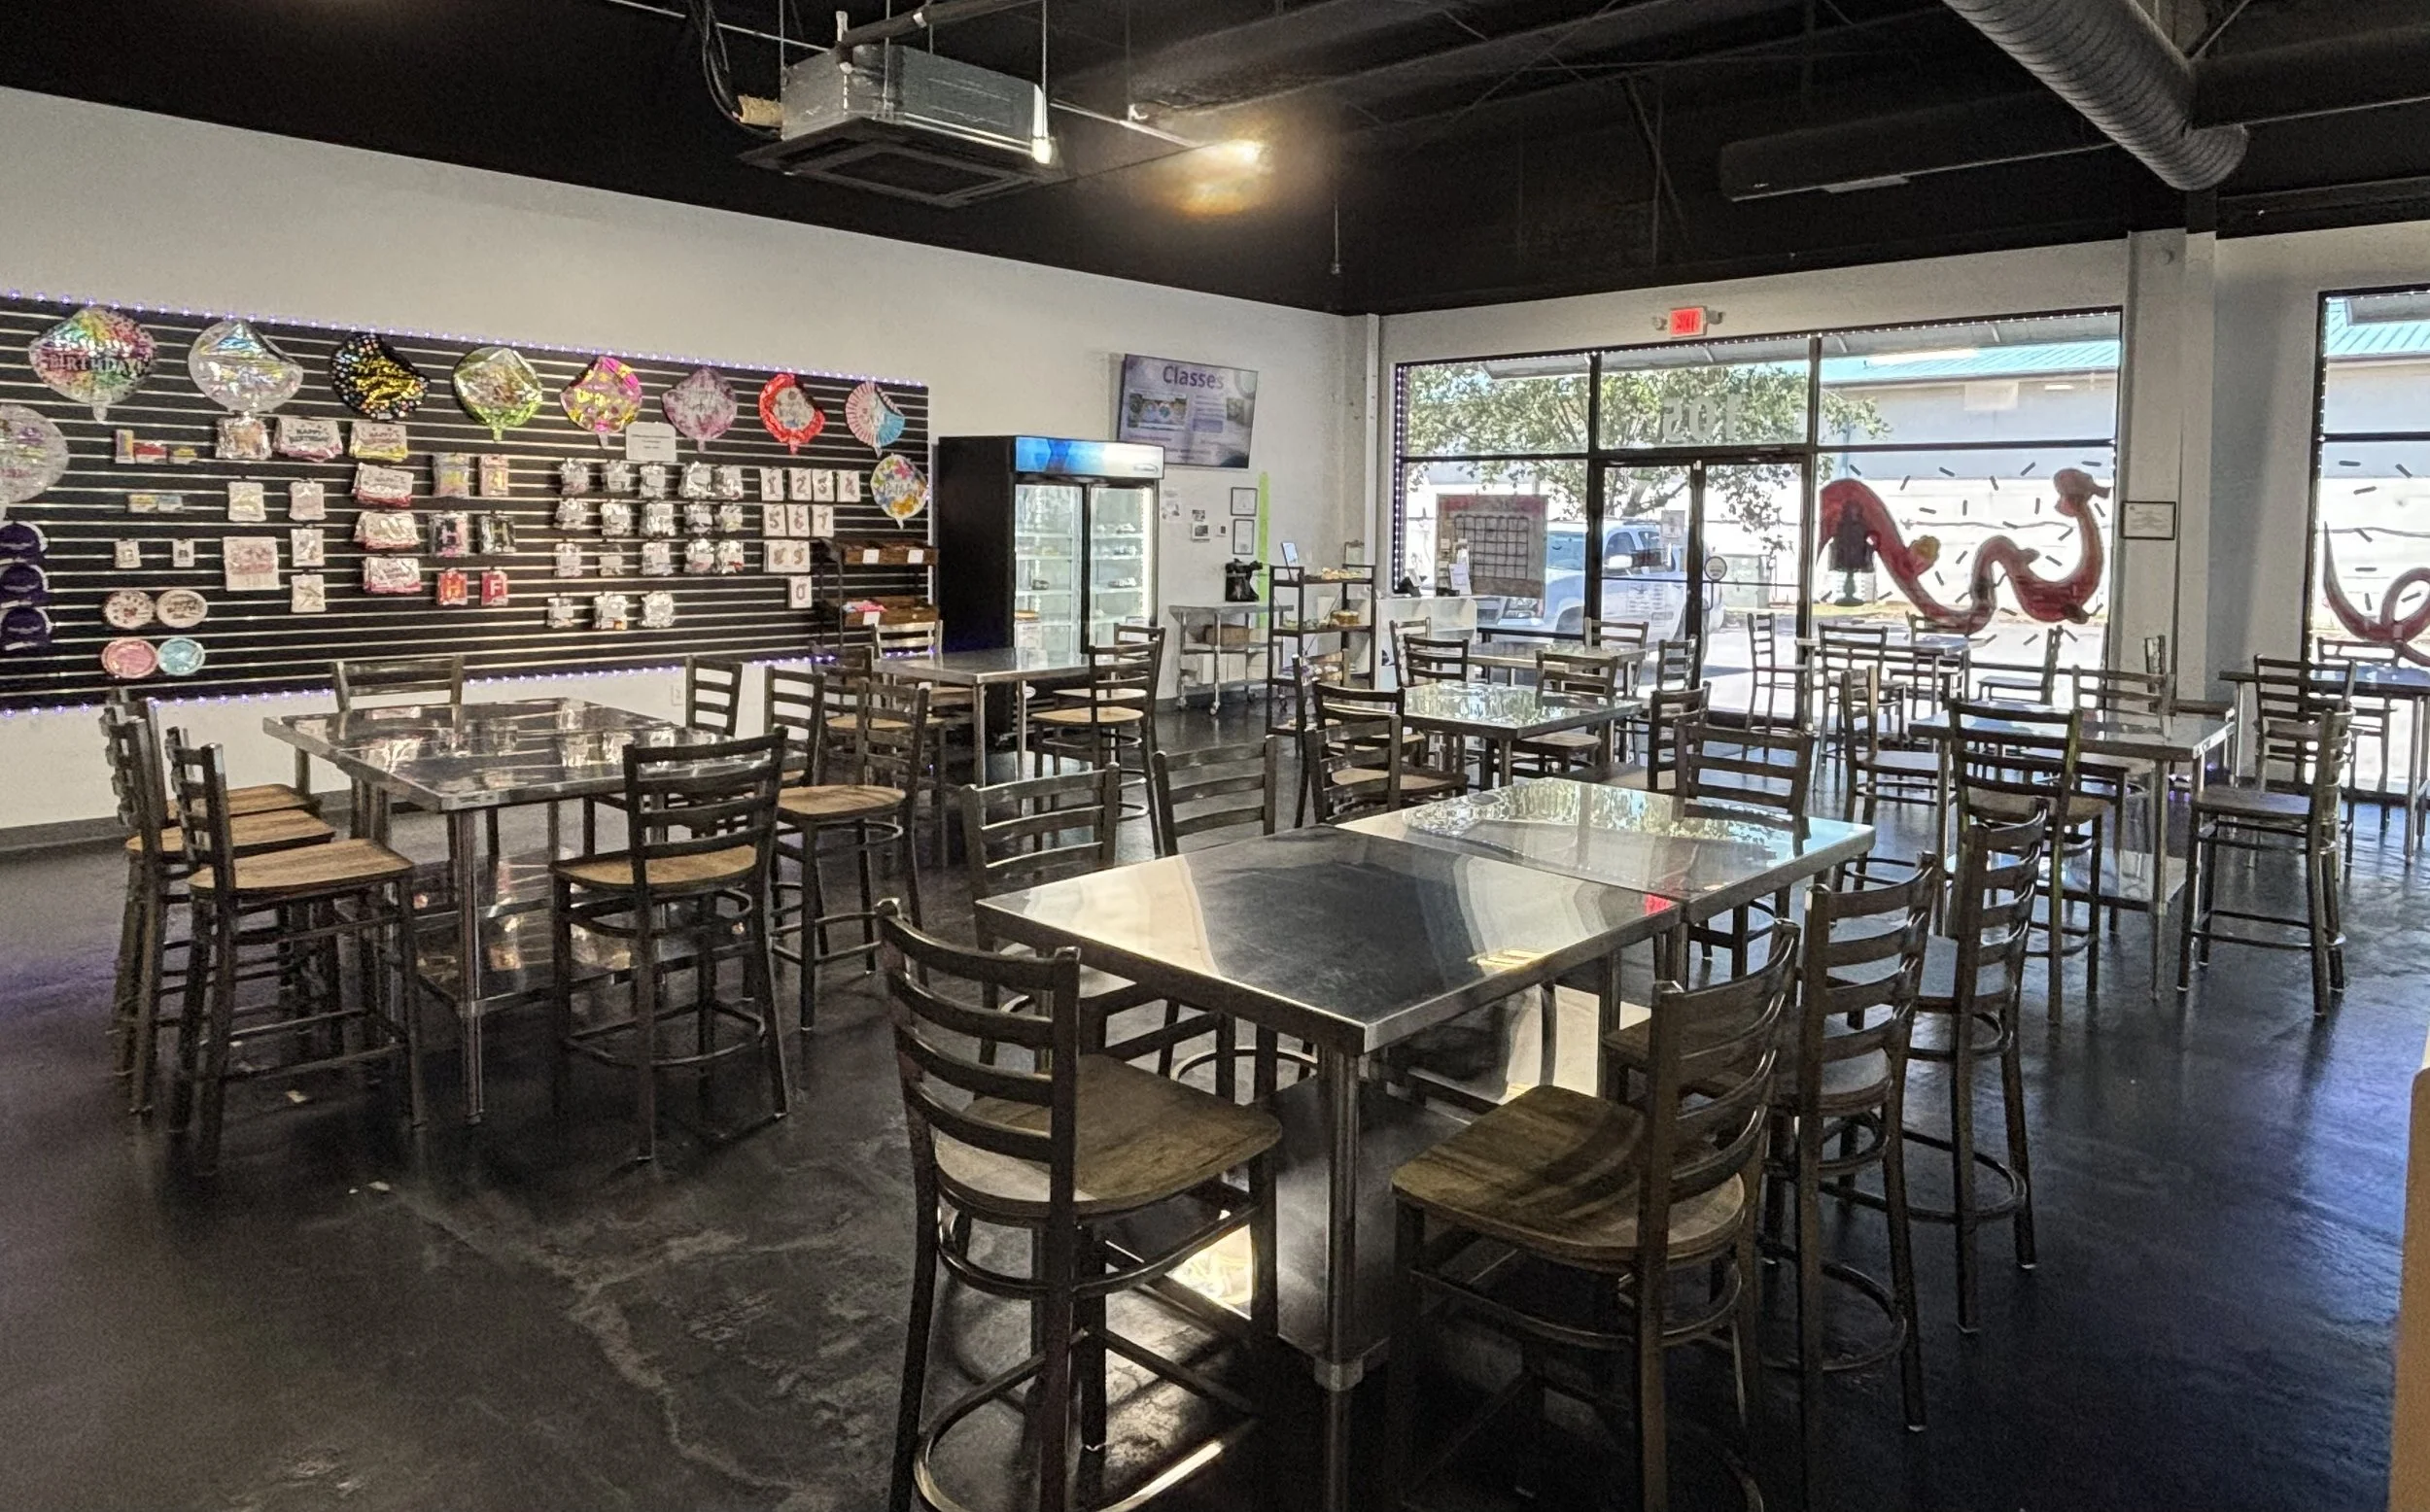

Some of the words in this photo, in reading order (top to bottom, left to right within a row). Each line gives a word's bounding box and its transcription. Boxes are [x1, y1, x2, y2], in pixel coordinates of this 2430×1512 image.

[1163, 365, 1225, 390] Classes
[796, 475, 807, 494] 2
[769, 509, 781, 529] 5
